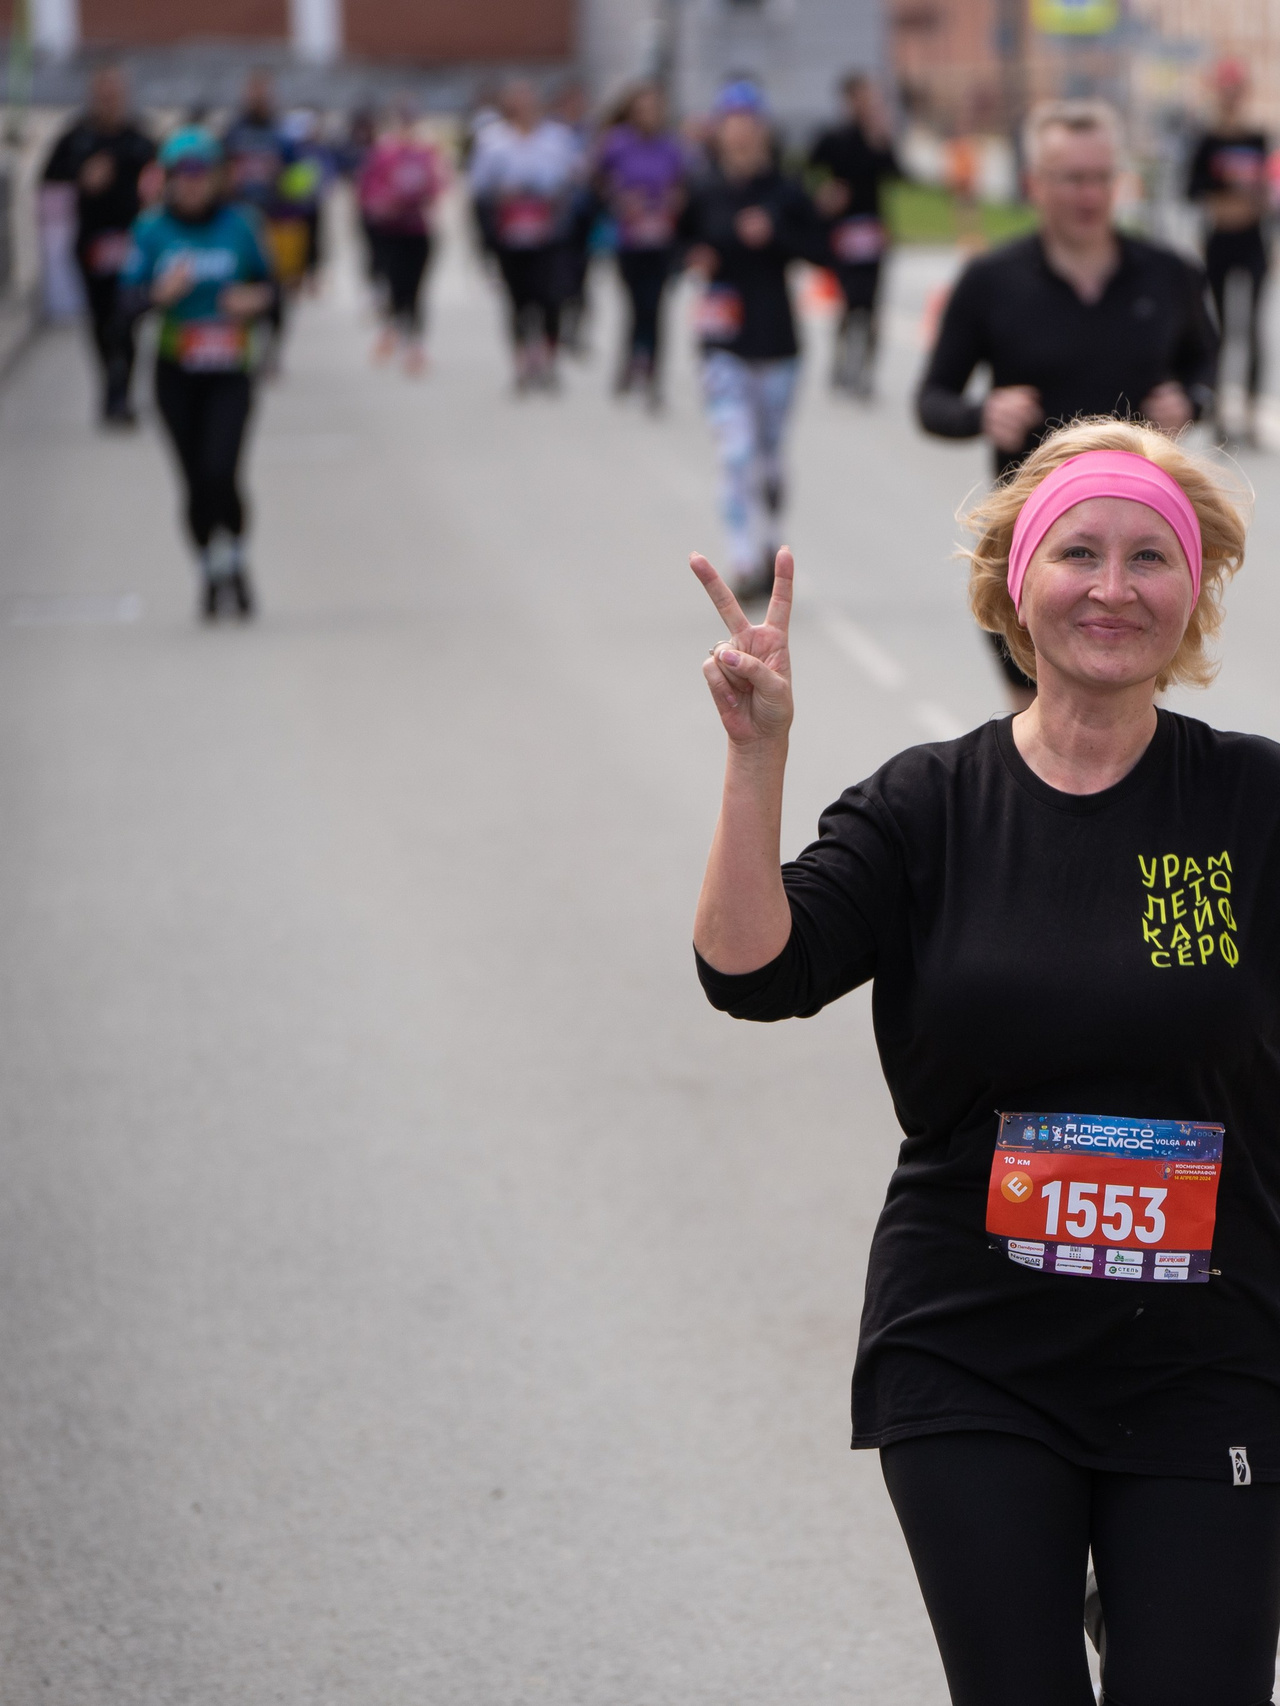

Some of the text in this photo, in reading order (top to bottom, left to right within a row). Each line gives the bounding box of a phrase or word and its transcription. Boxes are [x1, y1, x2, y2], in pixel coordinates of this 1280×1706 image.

[1138, 850, 1233, 889] УРАМ
[1065, 1123, 1154, 1138] Я ПРОСТО
[1063, 1134, 1154, 1150] КОСМОС
[1003, 1156, 1015, 1165] 10
[1041, 1180, 1168, 1244] 1553
